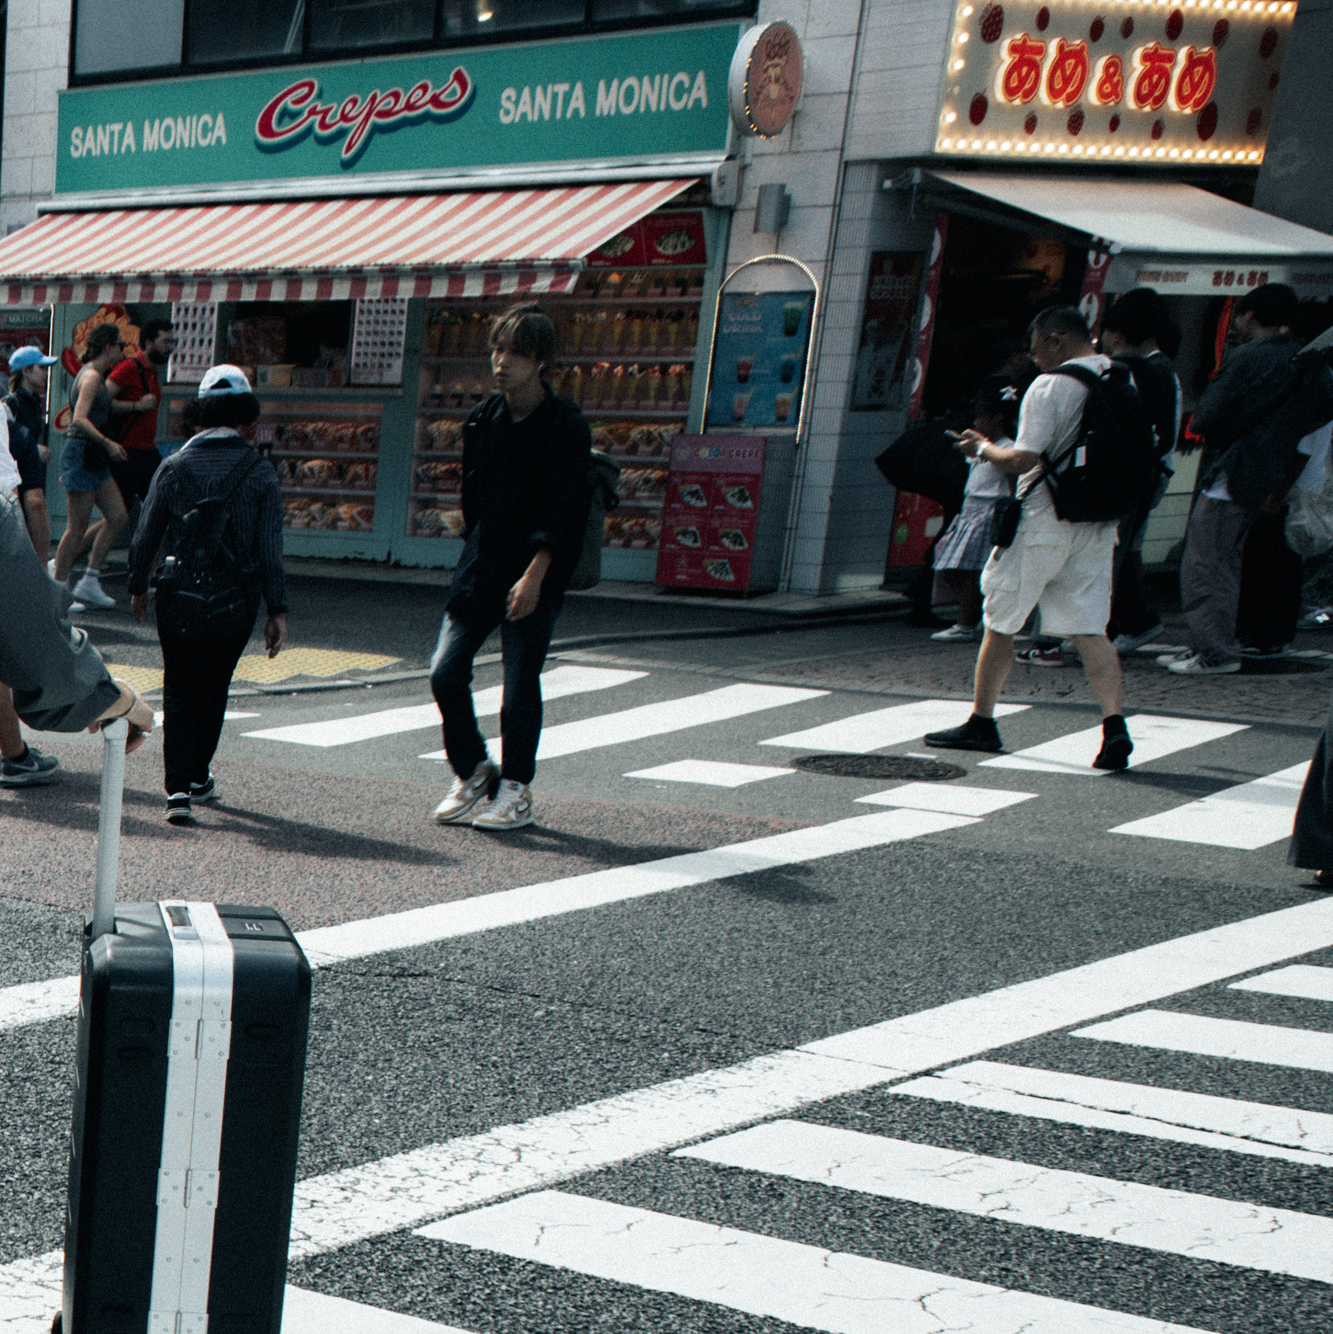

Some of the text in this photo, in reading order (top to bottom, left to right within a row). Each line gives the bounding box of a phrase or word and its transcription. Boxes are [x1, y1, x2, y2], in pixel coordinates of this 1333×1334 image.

[255, 64, 473, 161] Crepes
[499, 69, 708, 125] SANTA MONICA
[70, 112, 227, 158] SANTA MONICA
[693, 447, 726, 460] COLOR
